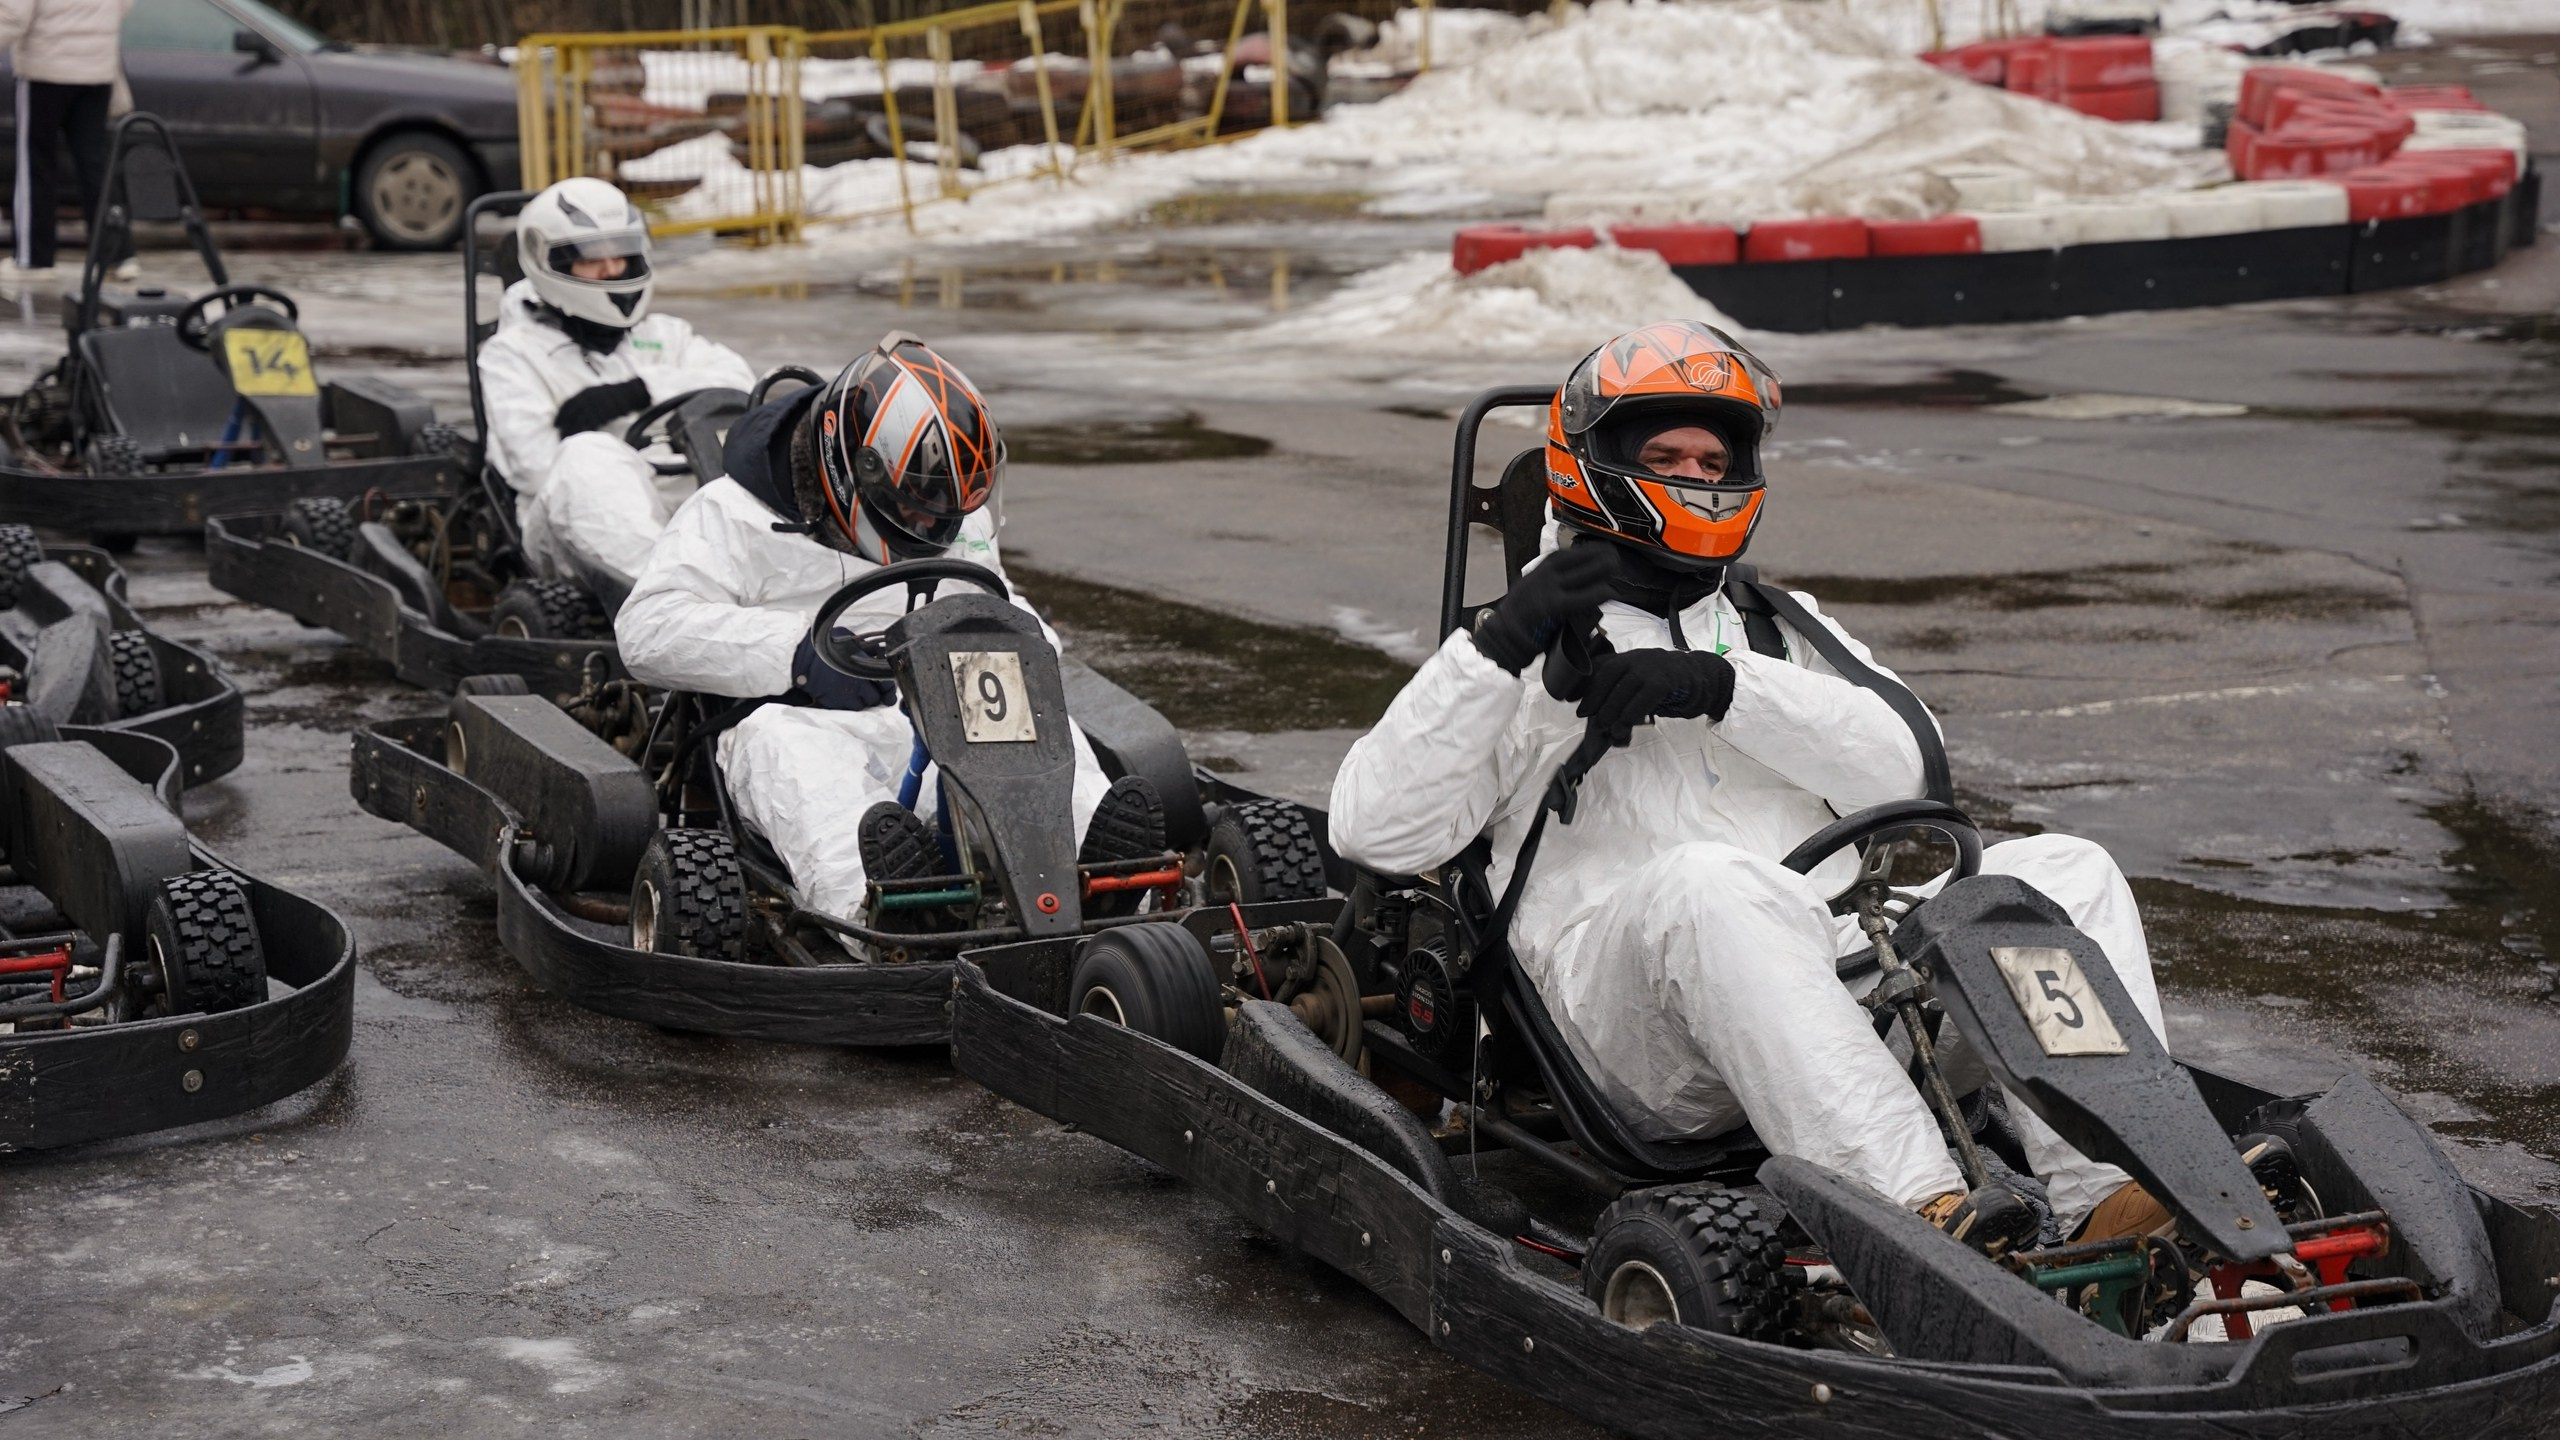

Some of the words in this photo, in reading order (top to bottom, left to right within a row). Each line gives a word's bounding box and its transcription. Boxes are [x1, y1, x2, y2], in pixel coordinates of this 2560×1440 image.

[241, 347, 297, 381] 14
[977, 671, 1007, 722] 9
[1410, 999, 1433, 1024] 6.5
[1411, 990, 1434, 1008] HONDA
[2034, 970, 2085, 1029] 5
[1206, 1085, 1290, 1150] PILOT
